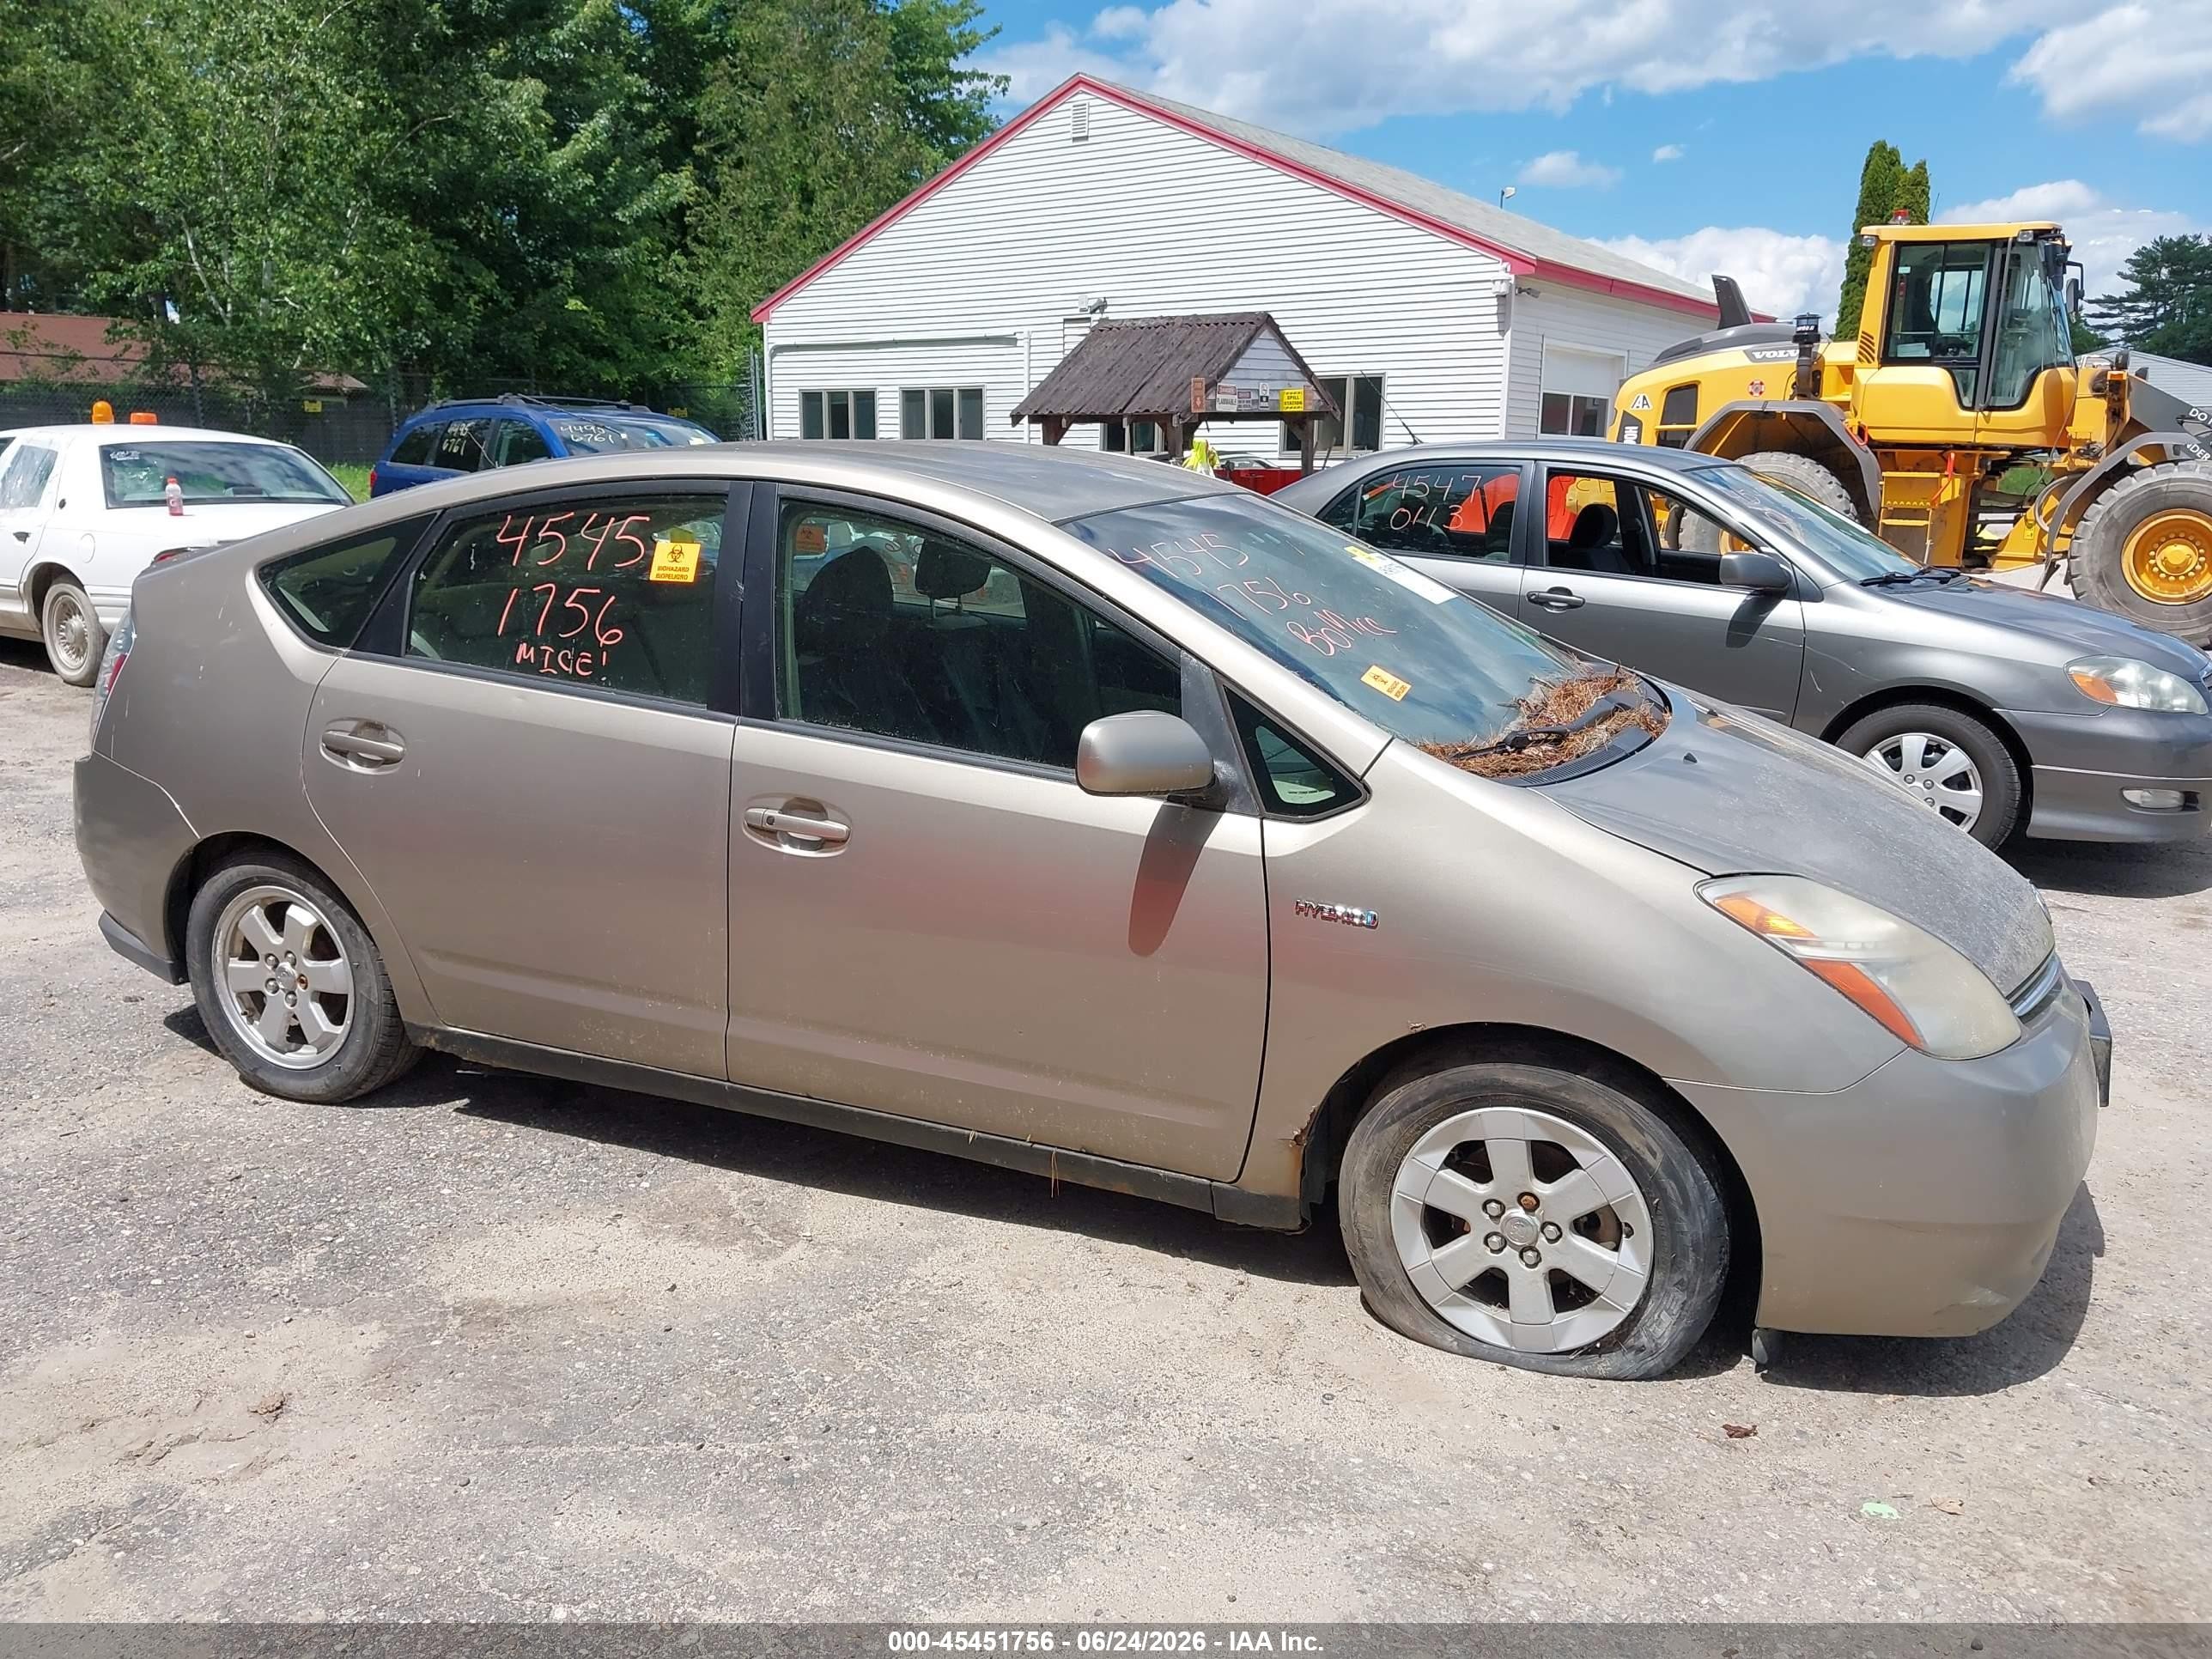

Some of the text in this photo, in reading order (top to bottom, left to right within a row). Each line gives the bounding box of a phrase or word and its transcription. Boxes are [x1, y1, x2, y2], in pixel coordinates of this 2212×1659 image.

[1751, 349, 1800, 359] VOLV
[2189, 408, 2208, 422] DO
[441, 438, 466, 456] 6761
[571, 433, 615, 445] 6761
[1392, 473, 1483, 503] 4547
[1389, 504, 1464, 531] 0113
[495, 511, 651, 571] 4545
[1108, 533, 1249, 579] 4545
[1202, 576, 1312, 621] 1756
[496, 582, 623, 647] 1756
